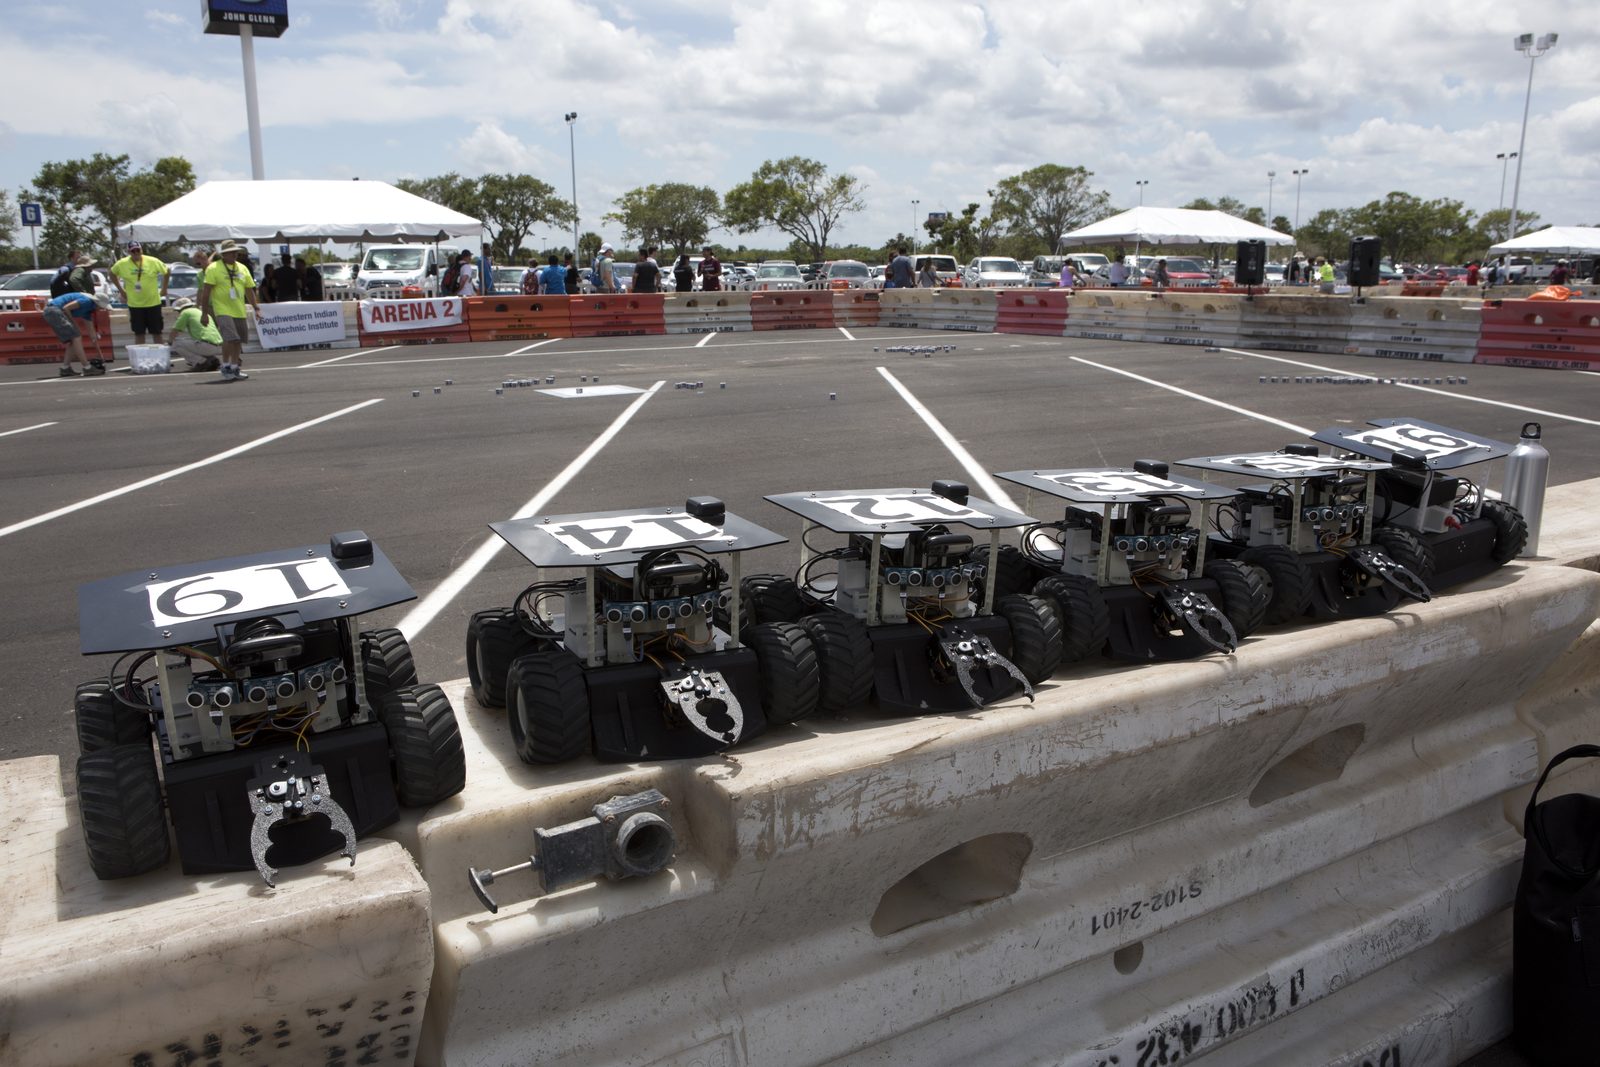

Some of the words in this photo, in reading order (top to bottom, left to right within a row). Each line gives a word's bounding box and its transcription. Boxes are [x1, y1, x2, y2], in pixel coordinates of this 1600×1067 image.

[223, 12, 245, 22] JOHN
[248, 14, 276, 24] GLENN
[25, 207, 36, 222] 6
[259, 310, 312, 325] Southwestern
[314, 309, 338, 319] Indian
[371, 301, 437, 323] ARENA
[443, 300, 455, 317] 2
[262, 324, 307, 337] Polytechnic
[308, 321, 339, 332] Institute
[818, 496, 975, 519] 12
[555, 516, 718, 549] 14
[156, 560, 338, 618] 19
[1091, 881, 1203, 935] S102-2401
